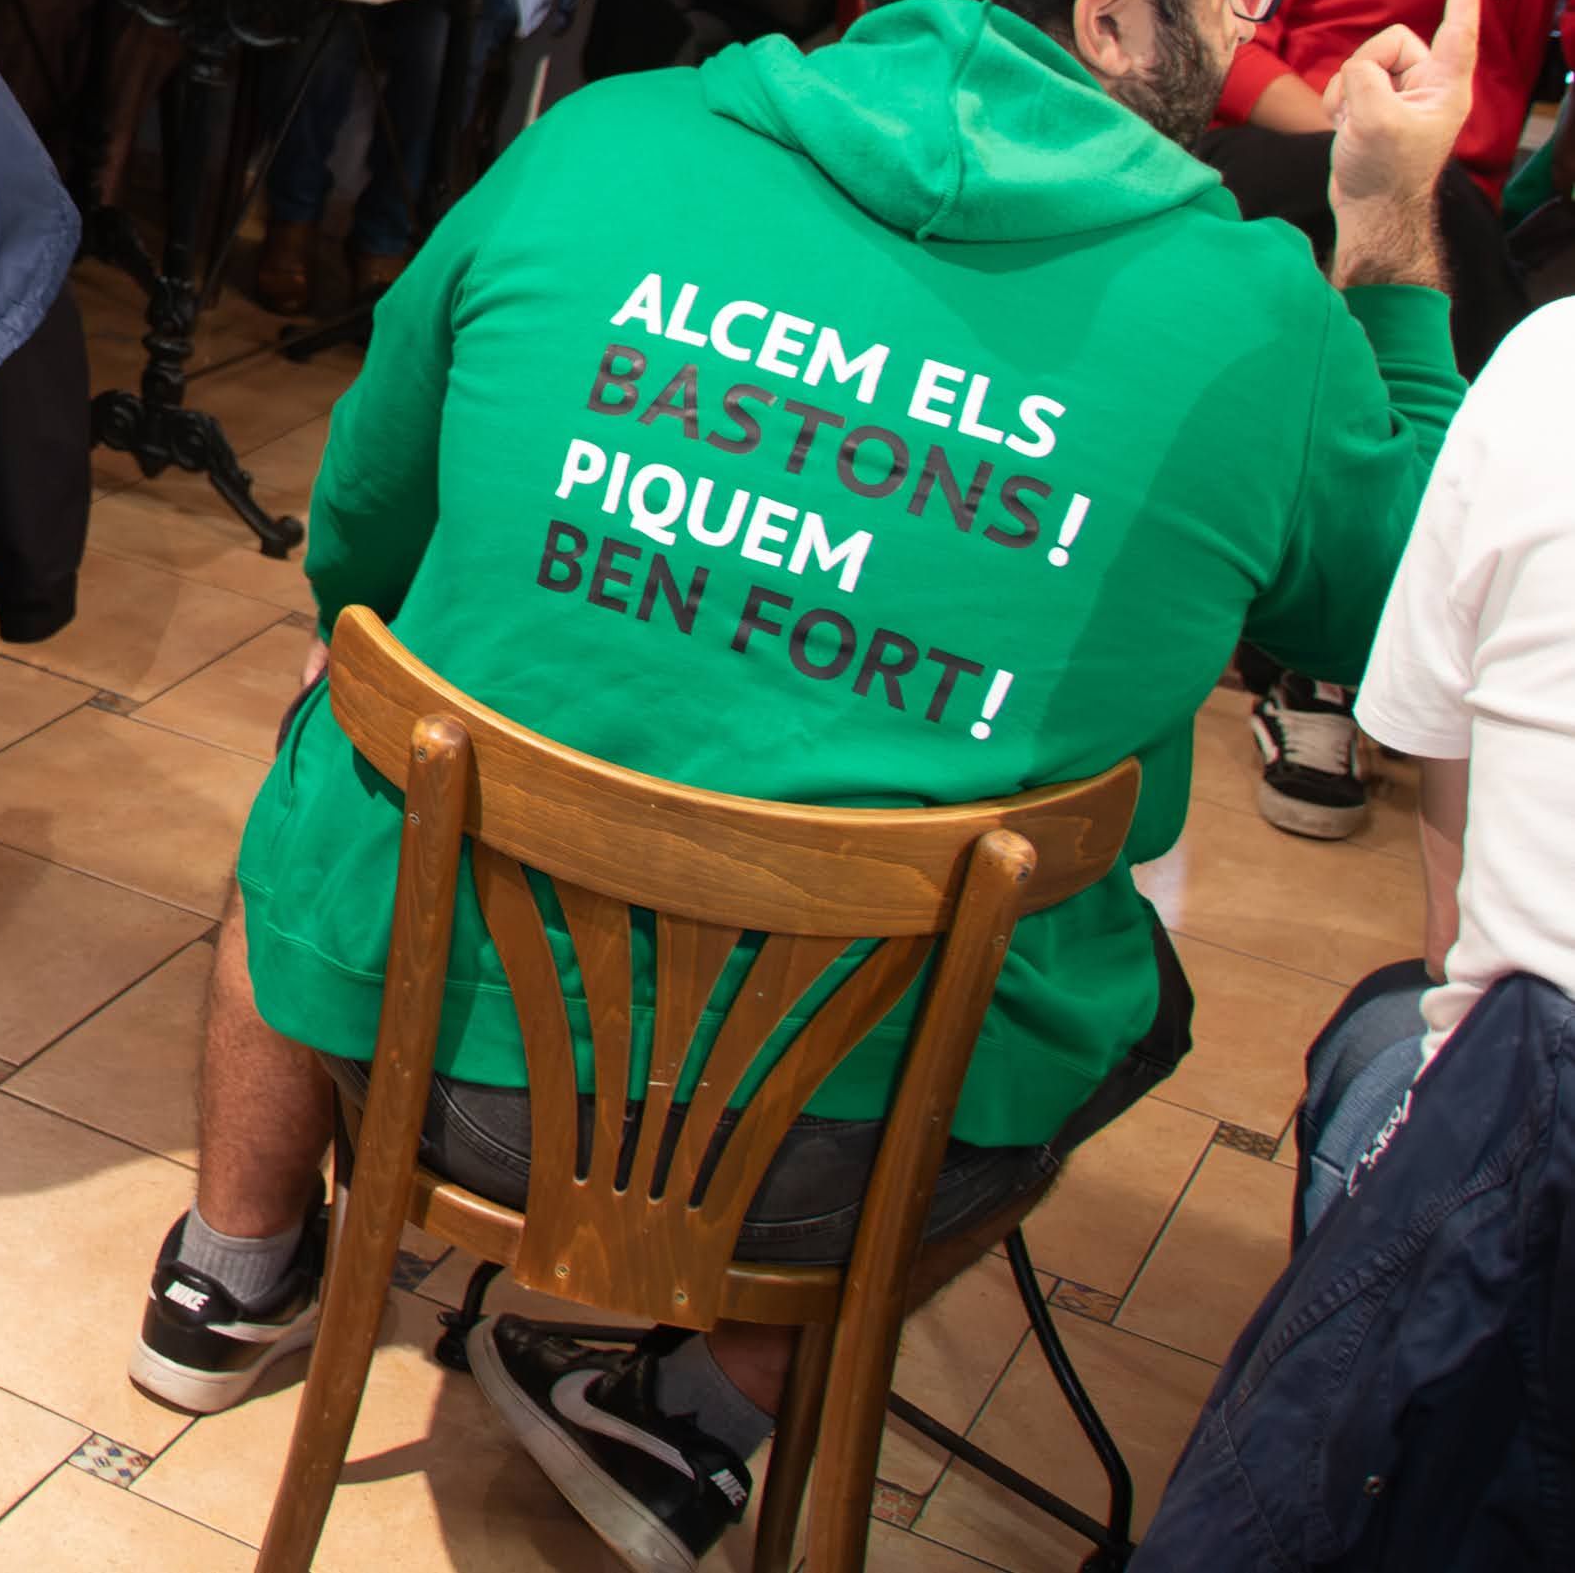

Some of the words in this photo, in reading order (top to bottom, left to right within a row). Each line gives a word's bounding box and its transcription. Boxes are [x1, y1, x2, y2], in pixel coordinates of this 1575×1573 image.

[609, 273, 891, 404] ALCEM
[906, 358, 1066, 458] ELS
[554, 438, 873, 594] PIQUEM
[584, 343, 1091, 568] BASTONS!
[535, 519, 711, 636] BEN
[729, 584, 1014, 740] FORT!
[163, 1280, 211, 1313] NIKE
[709, 1468, 748, 1507] NIKE
